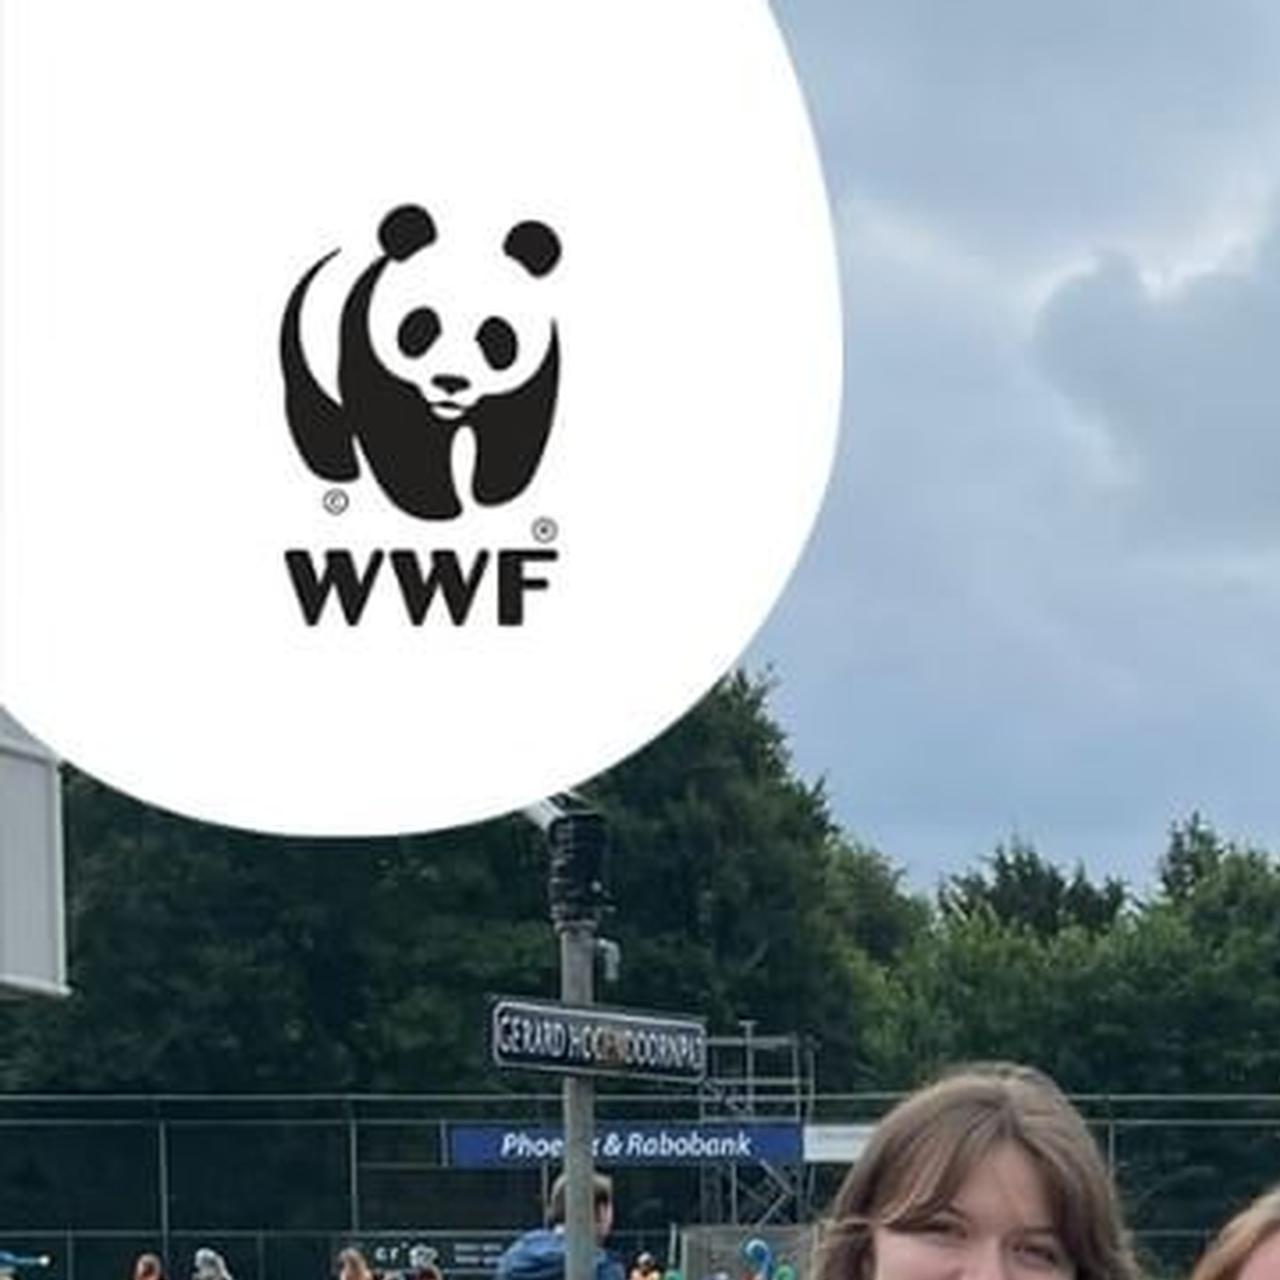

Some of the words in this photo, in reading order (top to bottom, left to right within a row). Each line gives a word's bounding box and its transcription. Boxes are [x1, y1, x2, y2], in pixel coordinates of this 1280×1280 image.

[499, 1015, 566, 1057] GERARD
[603, 1132, 623, 1157] &
[626, 1130, 752, 1157] Rabobank
